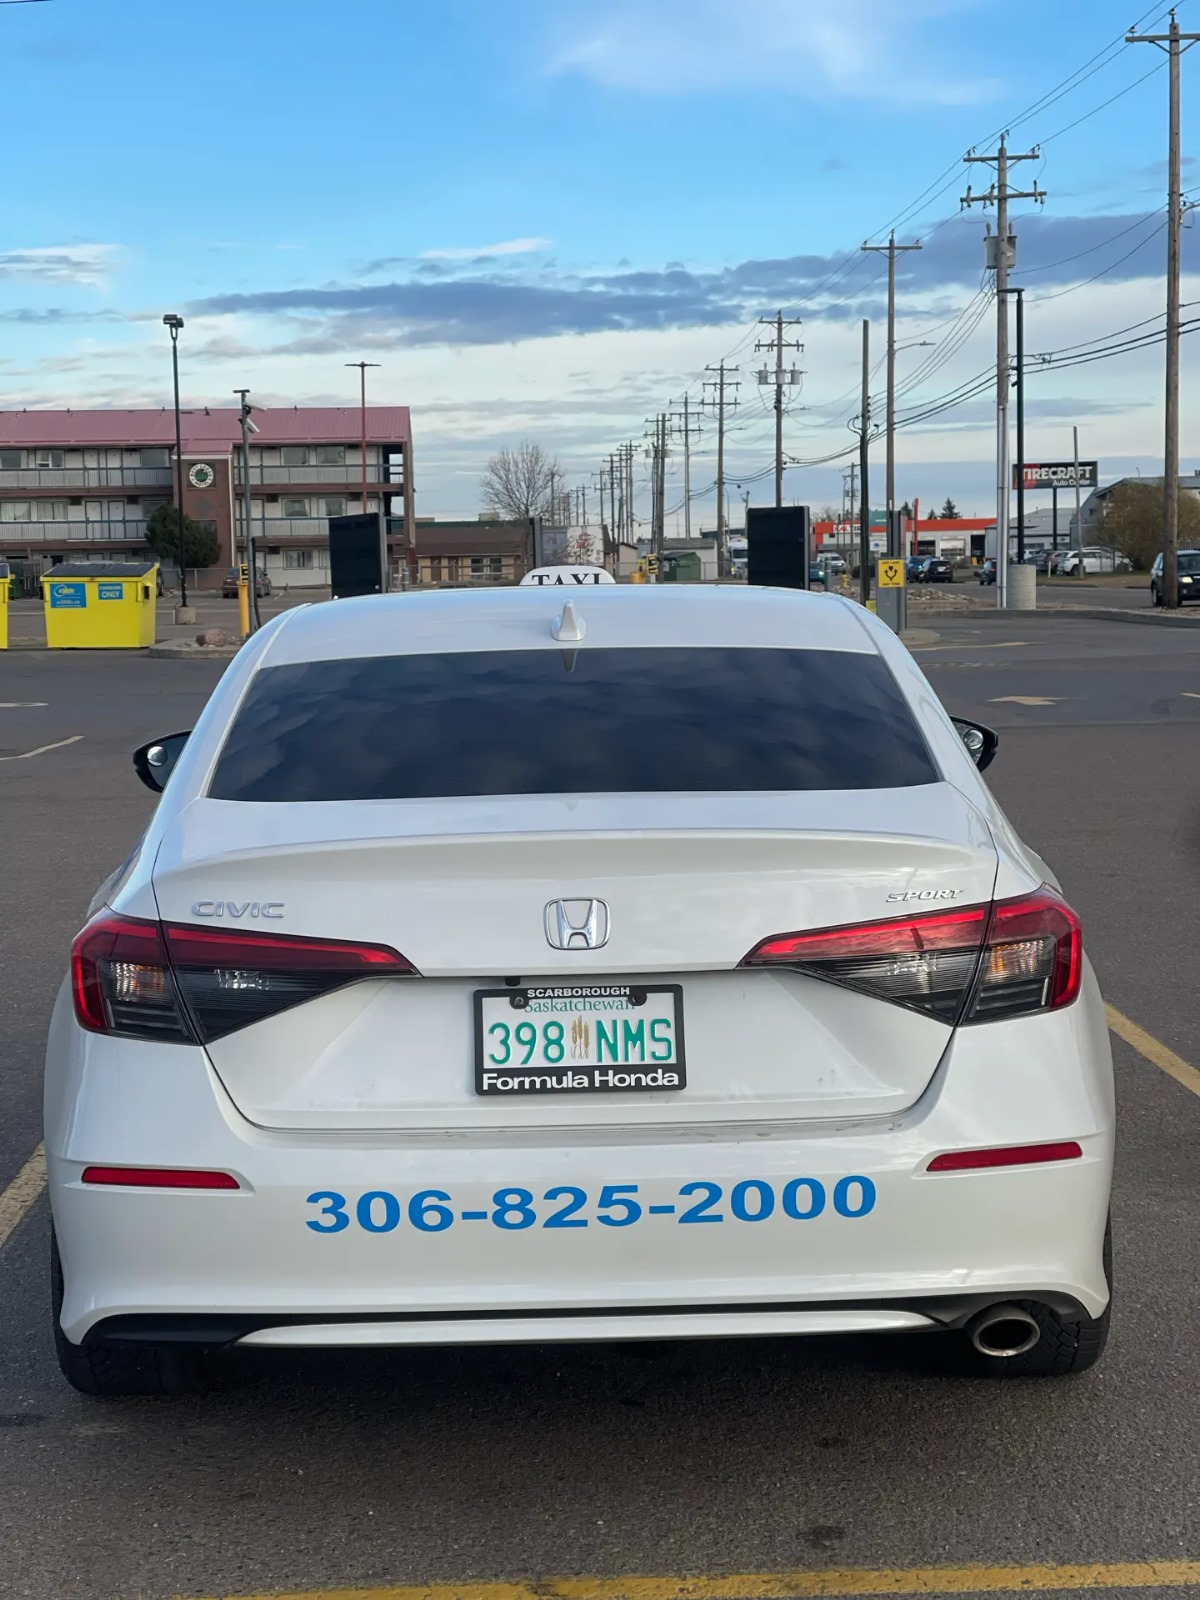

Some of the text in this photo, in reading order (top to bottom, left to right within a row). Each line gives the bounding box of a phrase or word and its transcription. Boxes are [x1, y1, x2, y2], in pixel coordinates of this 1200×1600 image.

[1023, 466, 1092, 480] TIRECRAFT
[532, 573, 602, 585] TAXI
[886, 889, 964, 903] SPORT
[192, 901, 285, 918] CIVIC
[527, 987, 630, 998] SCARBOROUGH
[524, 998, 635, 1013] Saskatchewan
[488, 1018, 673, 1065] 398 NMS
[482, 1069, 679, 1090] Formula Honda
[305, 1175, 877, 1233] 306-825-2000
